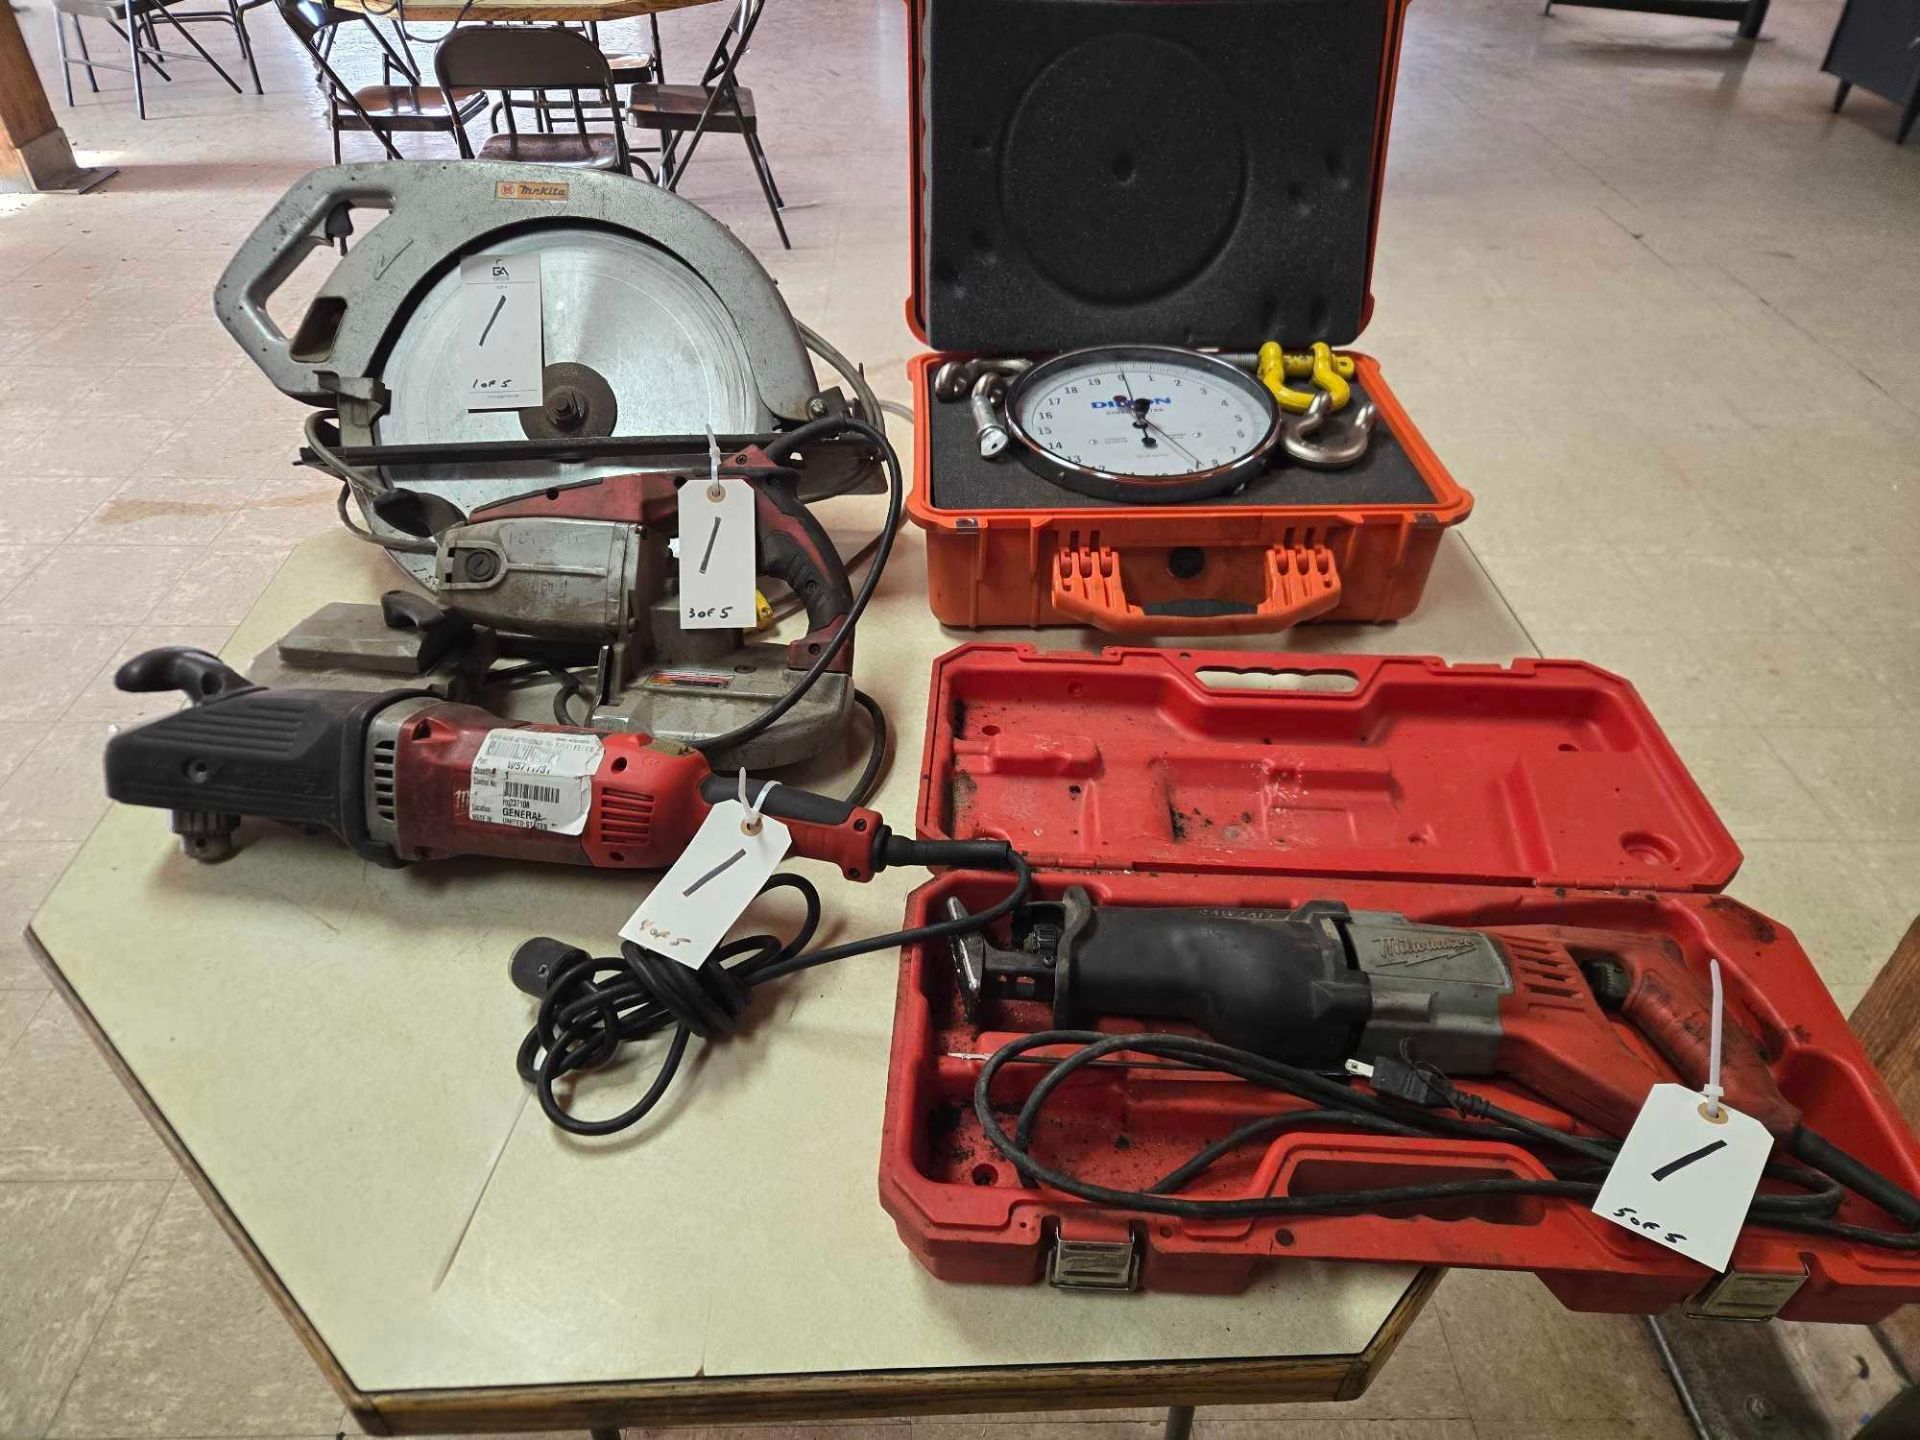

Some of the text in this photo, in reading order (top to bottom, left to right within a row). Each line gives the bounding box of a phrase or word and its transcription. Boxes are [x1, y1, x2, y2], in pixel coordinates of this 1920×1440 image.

[500, 379, 512, 388] 5
[1064, 386, 1079, 394] 18
[1049, 397, 1061, 406] 17
[1039, 412, 1053, 420] 16
[1038, 427, 1052, 435] 15
[1049, 442, 1063, 450] 14
[689, 608, 695, 619] 3
[719, 606, 733, 618] 5
[1613, 1207, 1637, 1217] 5
[1665, 1233, 1688, 1244] 5
